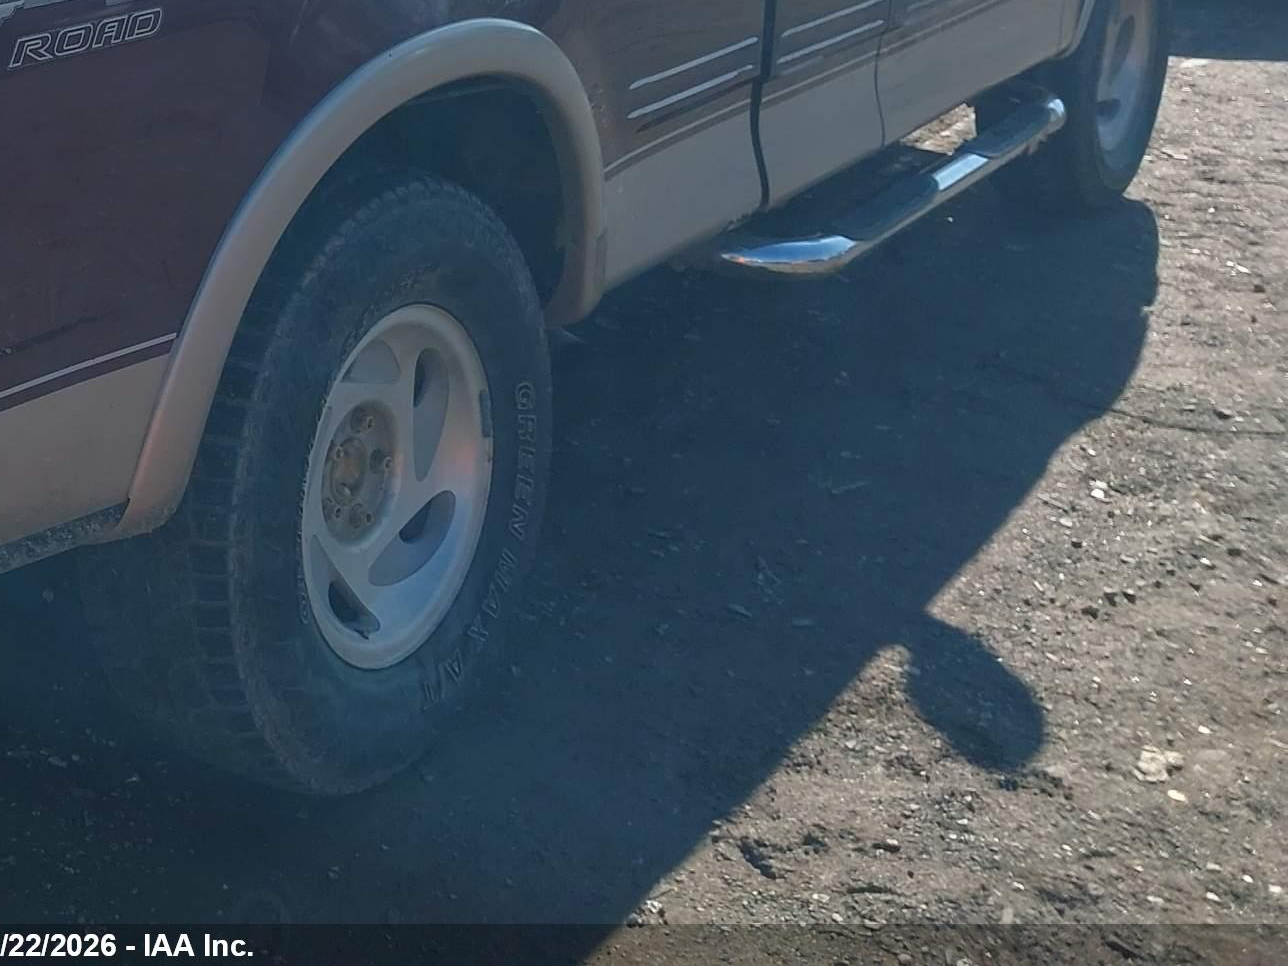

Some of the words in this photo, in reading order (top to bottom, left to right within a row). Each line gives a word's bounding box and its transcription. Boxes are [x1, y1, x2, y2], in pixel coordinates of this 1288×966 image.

[8, 8, 163, 70] ROAD
[509, 381, 537, 541] GREEN
[466, 547, 517, 643] MAX
